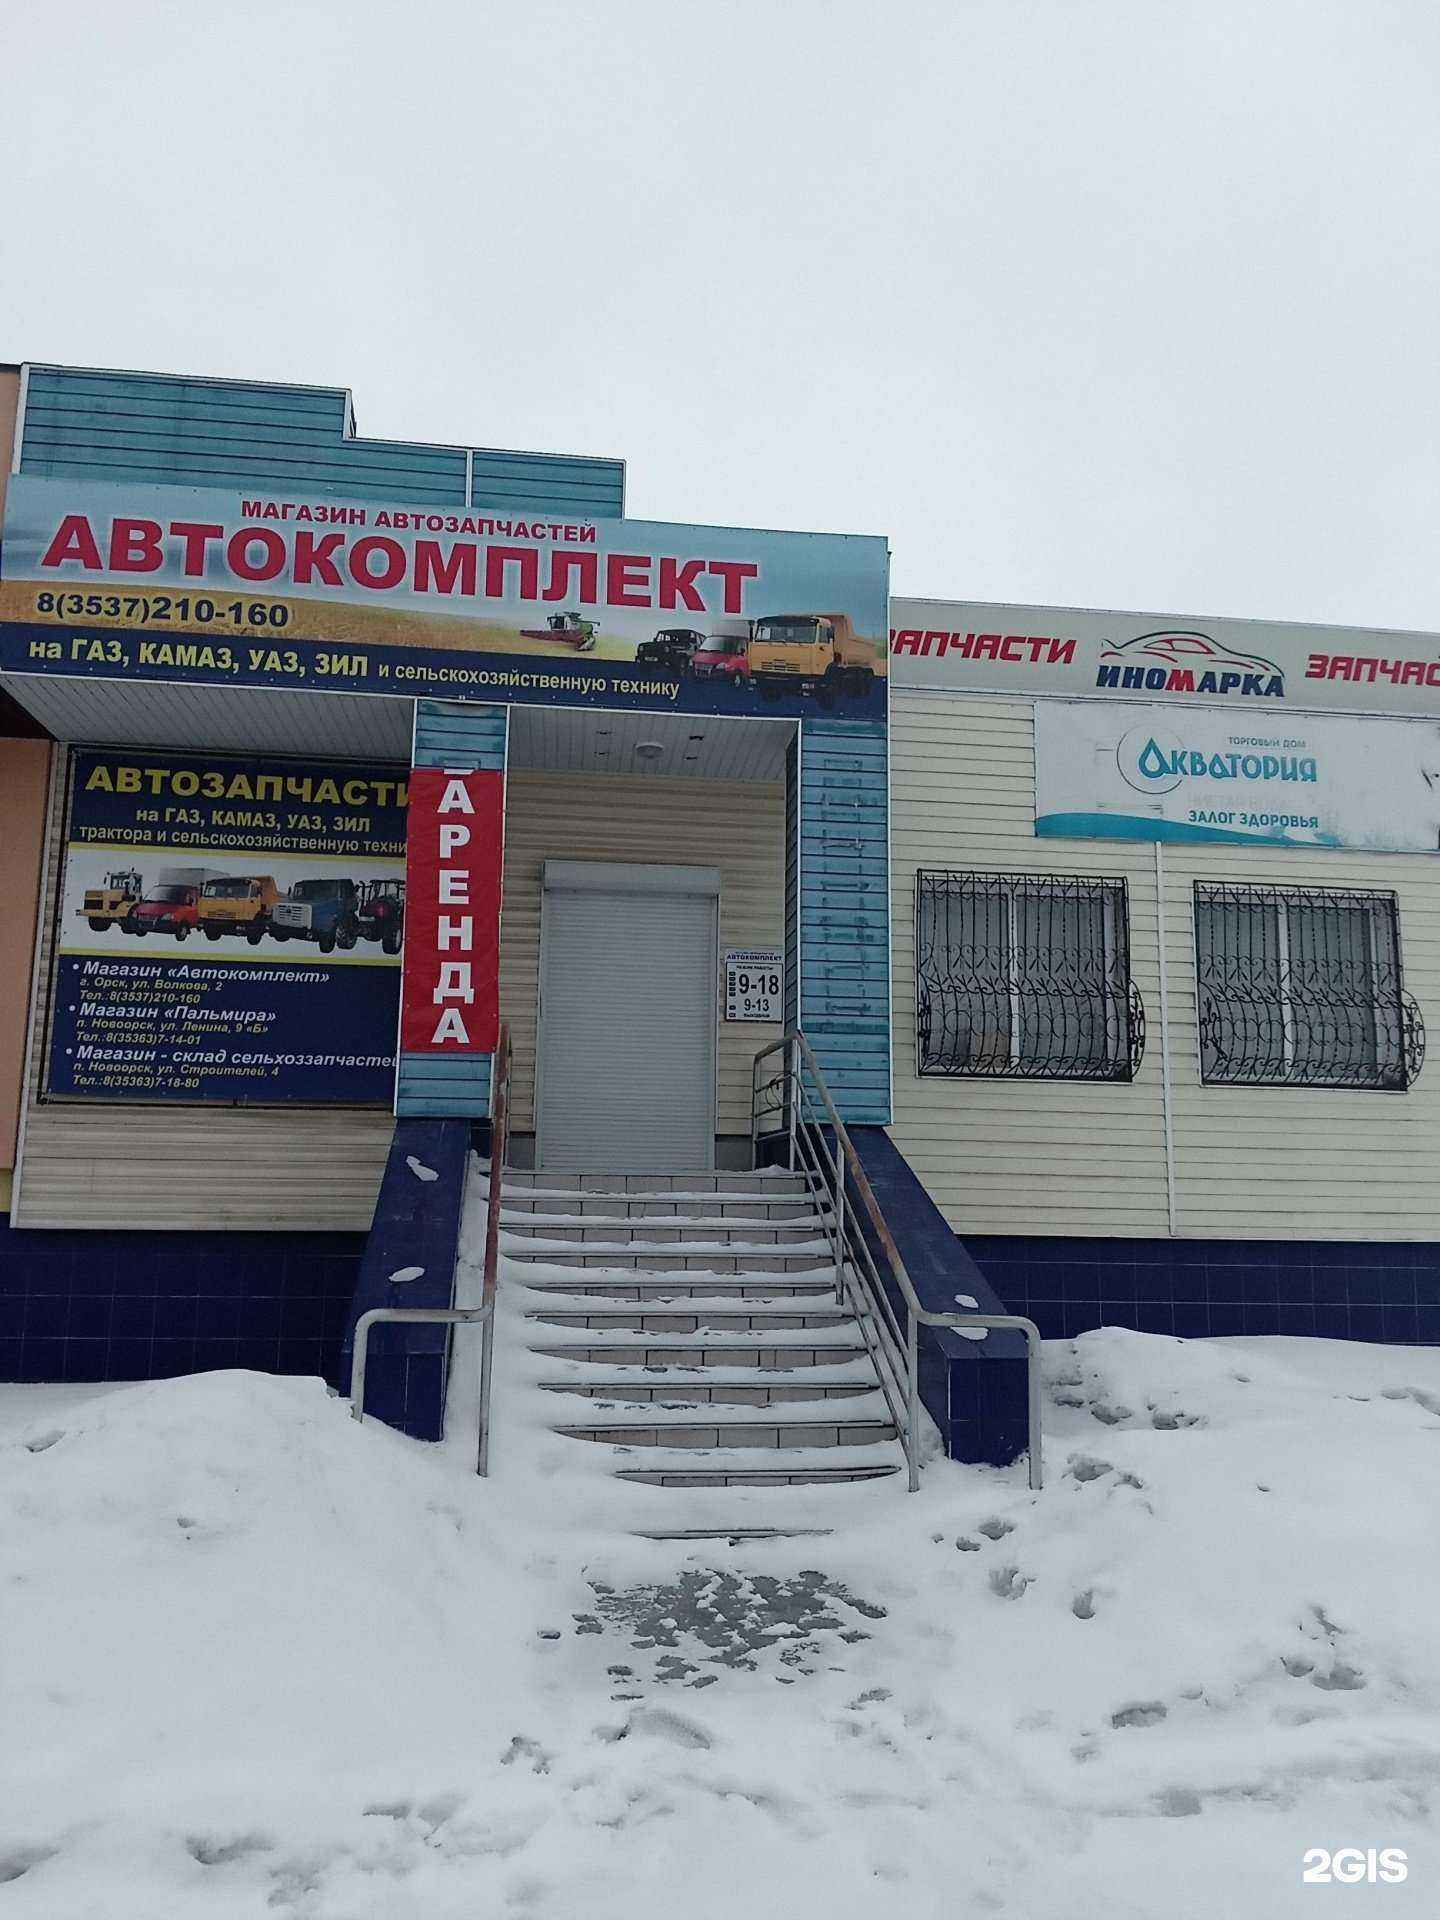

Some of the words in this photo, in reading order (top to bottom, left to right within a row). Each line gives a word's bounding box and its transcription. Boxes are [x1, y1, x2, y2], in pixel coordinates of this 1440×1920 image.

[241, 500, 366, 526] МАГАЗИН
[374, 510, 596, 544] АВТОЗАПЧАСТЕЙ
[41, 515, 758, 614] АВТОКОМПЛЕКТ
[37, 592, 289, 627] 8(3537)210-160
[29, 639, 61, 659] на
[70, 638, 129, 668] ГАЗ,
[138, 642, 240, 673] КАМАЗ,
[248, 648, 305, 677] УАЗ,
[313, 652, 369, 678] ЗИЛ
[378, 664, 389, 678] и
[395, 664, 606, 695] сельскохозяйственную
[611, 677, 680, 700] технику
[1305, 654, 1440, 687] ЗАПЧАС
[1096, 664, 1286, 699] ИНОМАРКА
[1228, 736, 1280, 748] ТОРГОВЫЙ
[1283, 739, 1307, 748] ДОМ
[1138, 737, 1317, 782] АКВАТОРИЯ
[136, 808, 159, 823] на
[165, 808, 205, 827] ГАЗ,
[211, 811, 281, 831] КАМАЗ,
[287, 814, 326, 833] УАЗ,
[333, 816, 370, 832] ЗИЛ
[1188, 810, 1236, 825] ЗАЛОГ
[1239, 812, 1319, 829] ЗДОРОВЬЯ
[79, 826, 152, 844] трактора
[157, 830, 166, 842] и
[171, 831, 359, 853] сельскохозяйственную
[431, 780, 476, 1043] АРЕНДА
[83, 961, 162, 977] Магазин
[167, 965, 330, 983] «Автокомплект»
[94, 977, 129, 989] Орск,
[131, 979, 150, 990] ул.
[154, 979, 211, 991] Волкова,
[215, 982, 223, 991] 2
[738, 973, 779, 995] 9-18
[79, 1002, 159, 1018] Магазин
[164, 1005, 276, 1024] «Пальмира»
[744, 998, 770, 1011] 9-13
[91, 1018, 156, 1032] Новоорск,
[160, 1022, 178, 1032] ул.
[182, 1022, 231, 1034] Ленина,
[236, 1023, 243, 1032] 9
[76, 1045, 156, 1061] Магазин
[172, 1049, 228, 1064] склад
[88, 1061, 153, 1074] Новоорск,
[157, 1065, 175, 1075] ул.
[180, 1065, 268, 1077] Строителей,
[271, 1066, 279, 1076] 4
